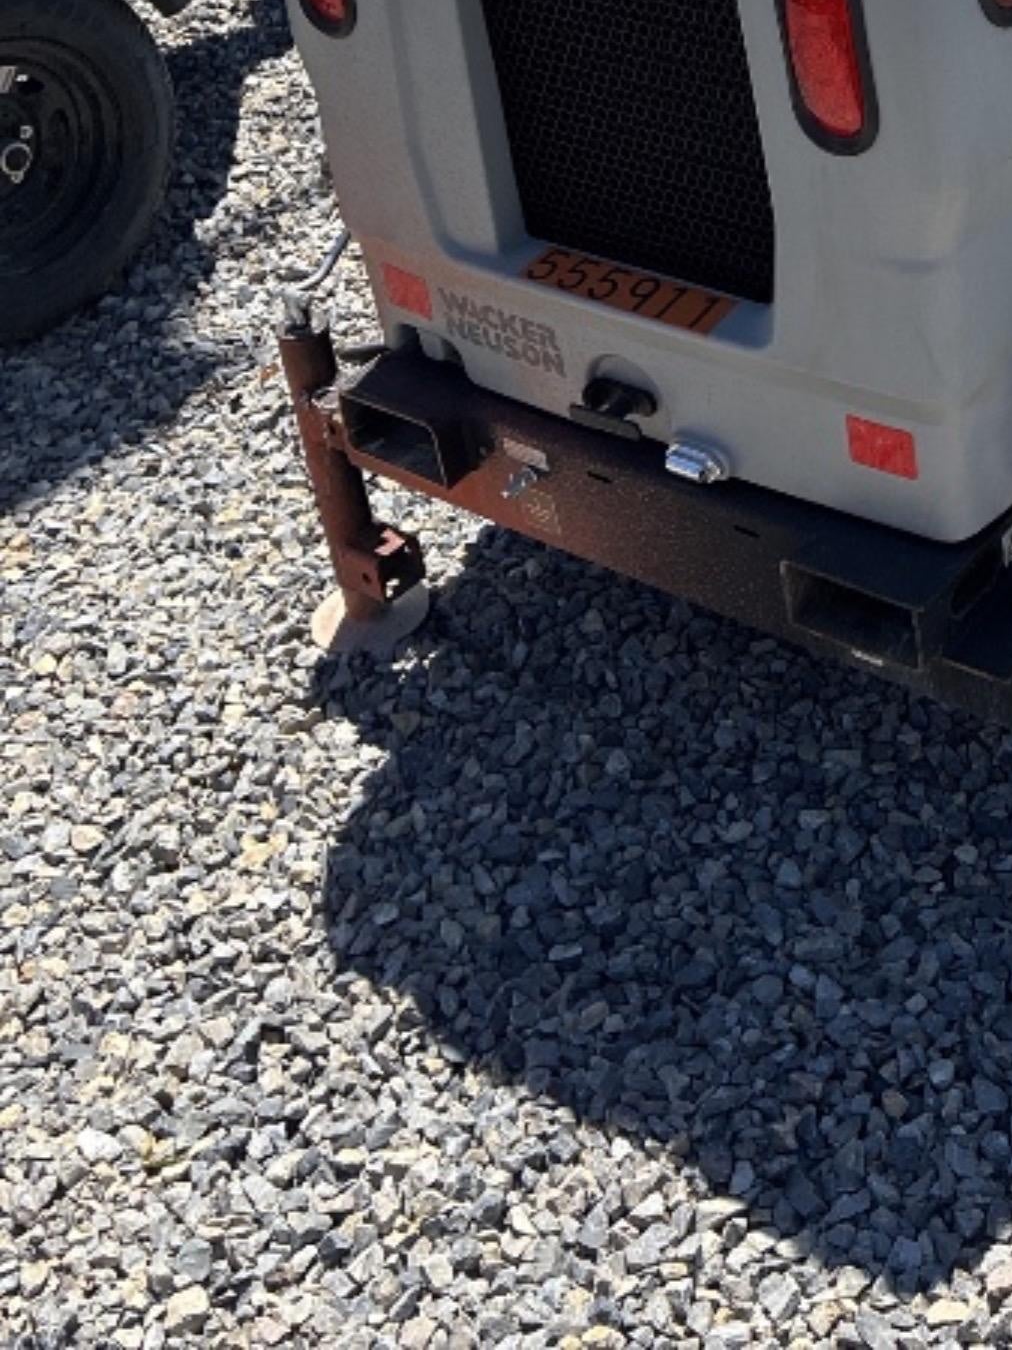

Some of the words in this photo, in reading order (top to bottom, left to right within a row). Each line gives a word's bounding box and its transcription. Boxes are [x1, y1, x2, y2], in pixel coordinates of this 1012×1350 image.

[437, 286, 559, 349] WACKER
[525, 249, 720, 330] 555911
[446, 316, 567, 379] NEUSON
